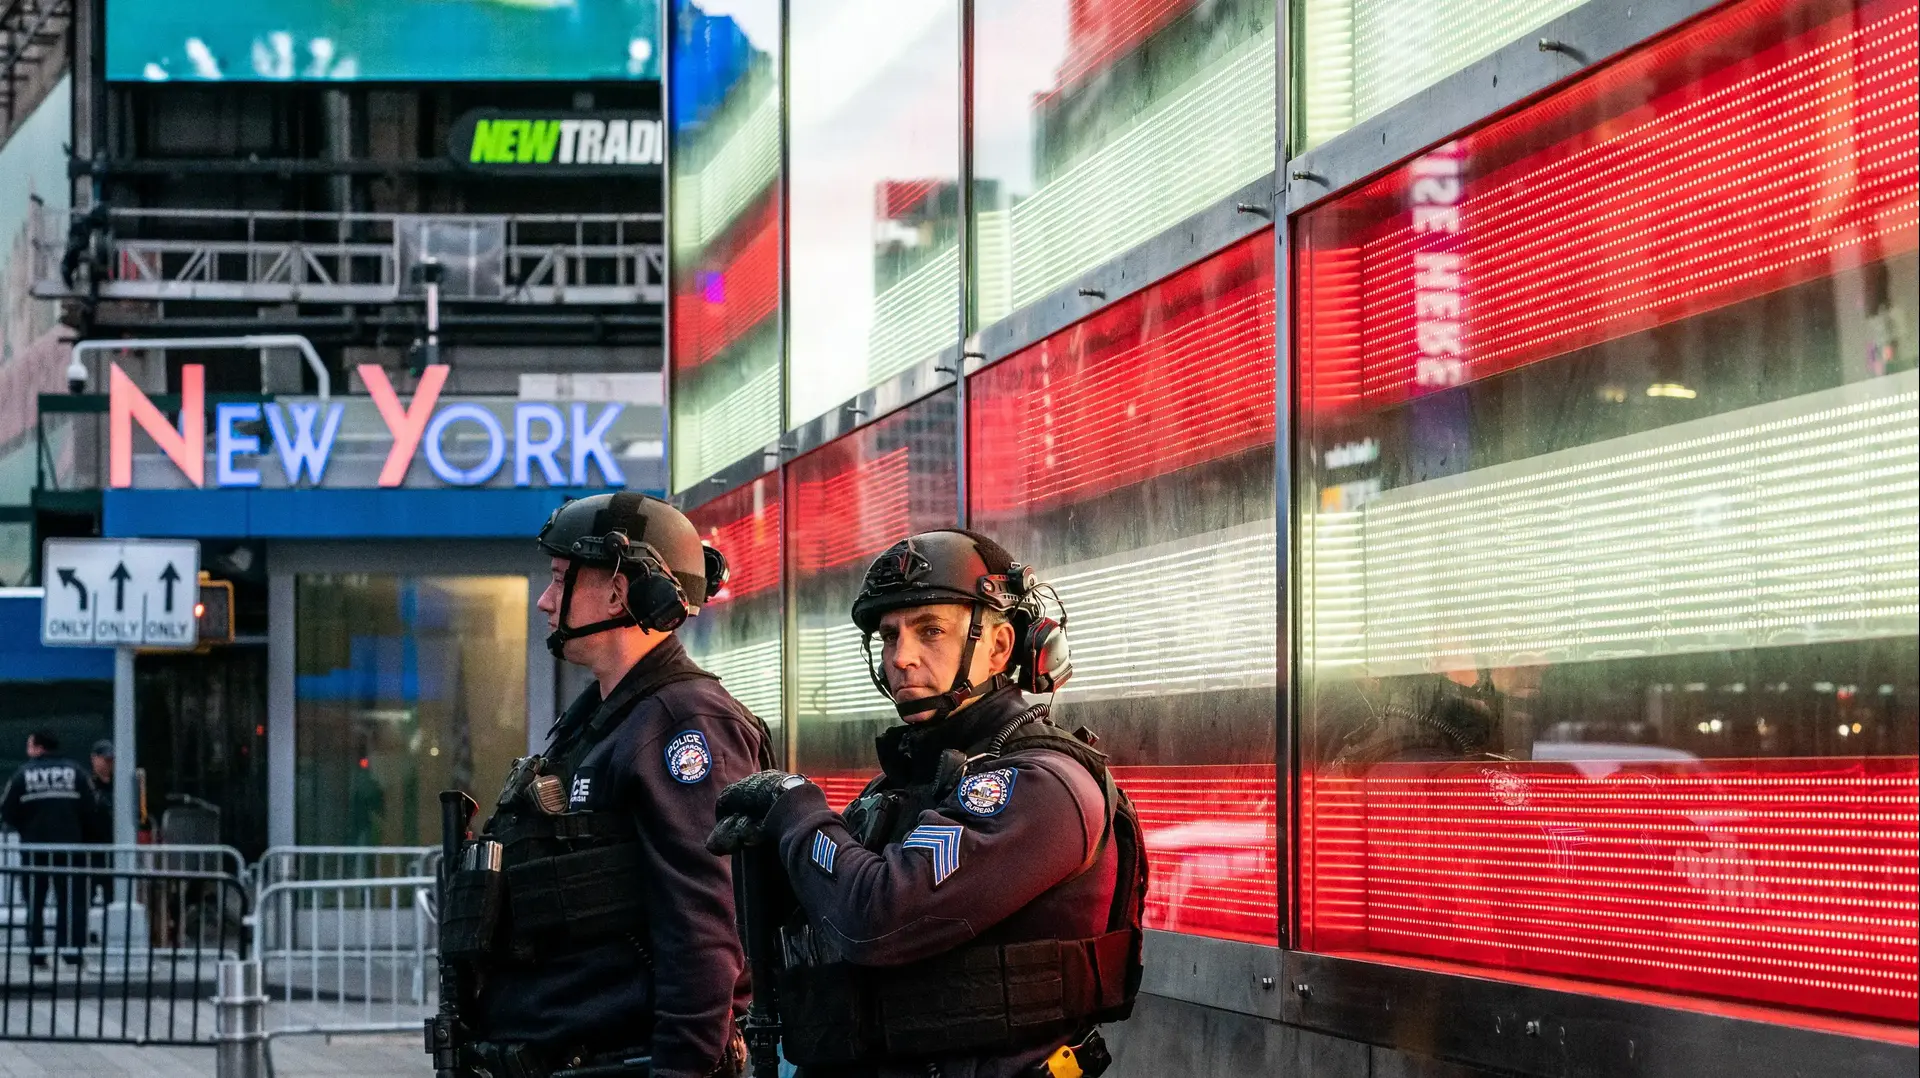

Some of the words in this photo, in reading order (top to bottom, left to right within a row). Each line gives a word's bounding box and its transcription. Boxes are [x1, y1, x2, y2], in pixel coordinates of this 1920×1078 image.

[110, 362, 344, 488] NEW
[358, 364, 627, 488] YORK
[50, 620, 90, 637] ONLY
[96, 620, 139, 637] ONLY
[146, 620, 187, 637] ONLY
[667, 734, 702, 758] POLICE
[965, 801, 995, 813] BUREAU
